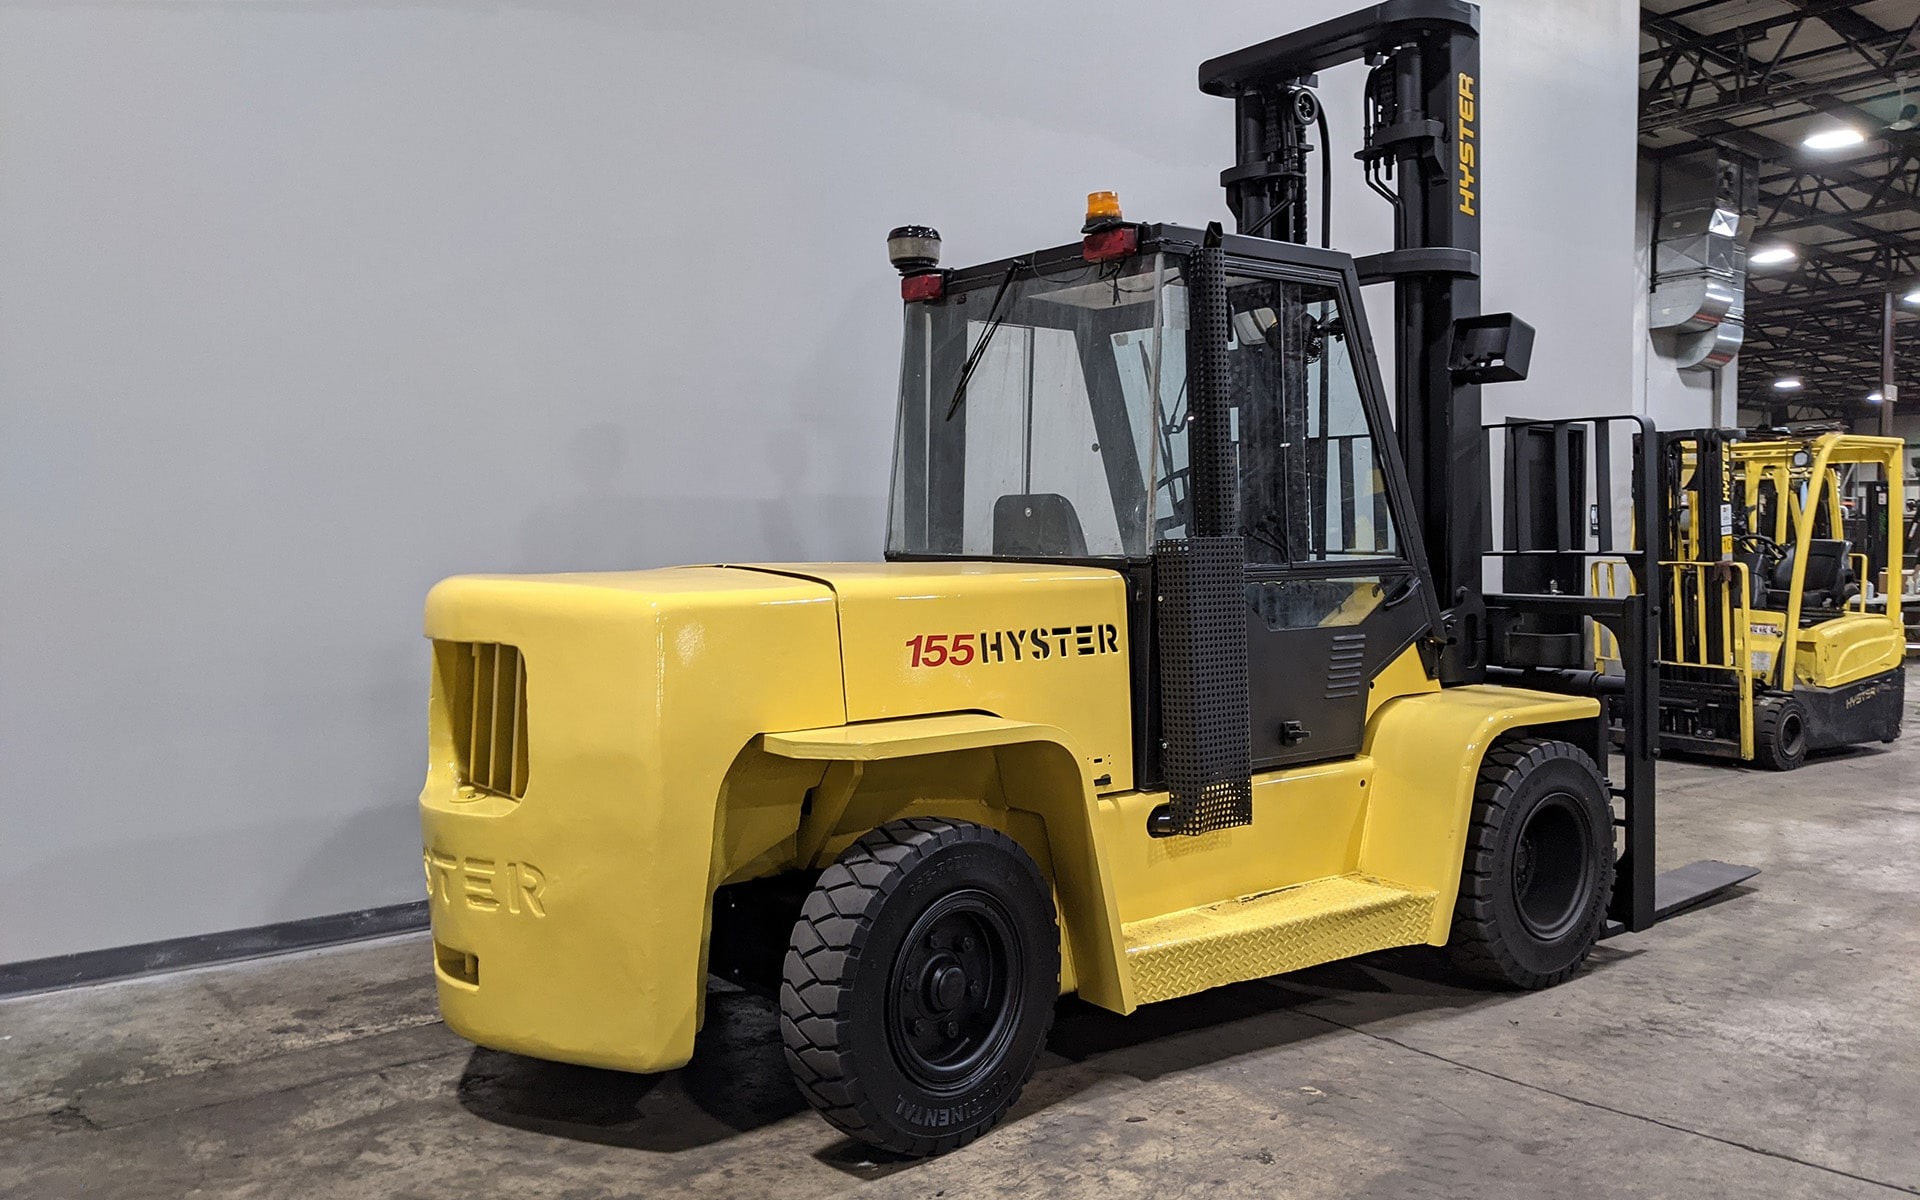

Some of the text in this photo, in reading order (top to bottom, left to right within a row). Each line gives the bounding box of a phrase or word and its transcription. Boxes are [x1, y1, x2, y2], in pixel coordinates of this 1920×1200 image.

[1459, 72, 1475, 216] HYSTER
[1721, 441, 1731, 502] HYSTER
[905, 623, 1120, 668] 155 HYSTER
